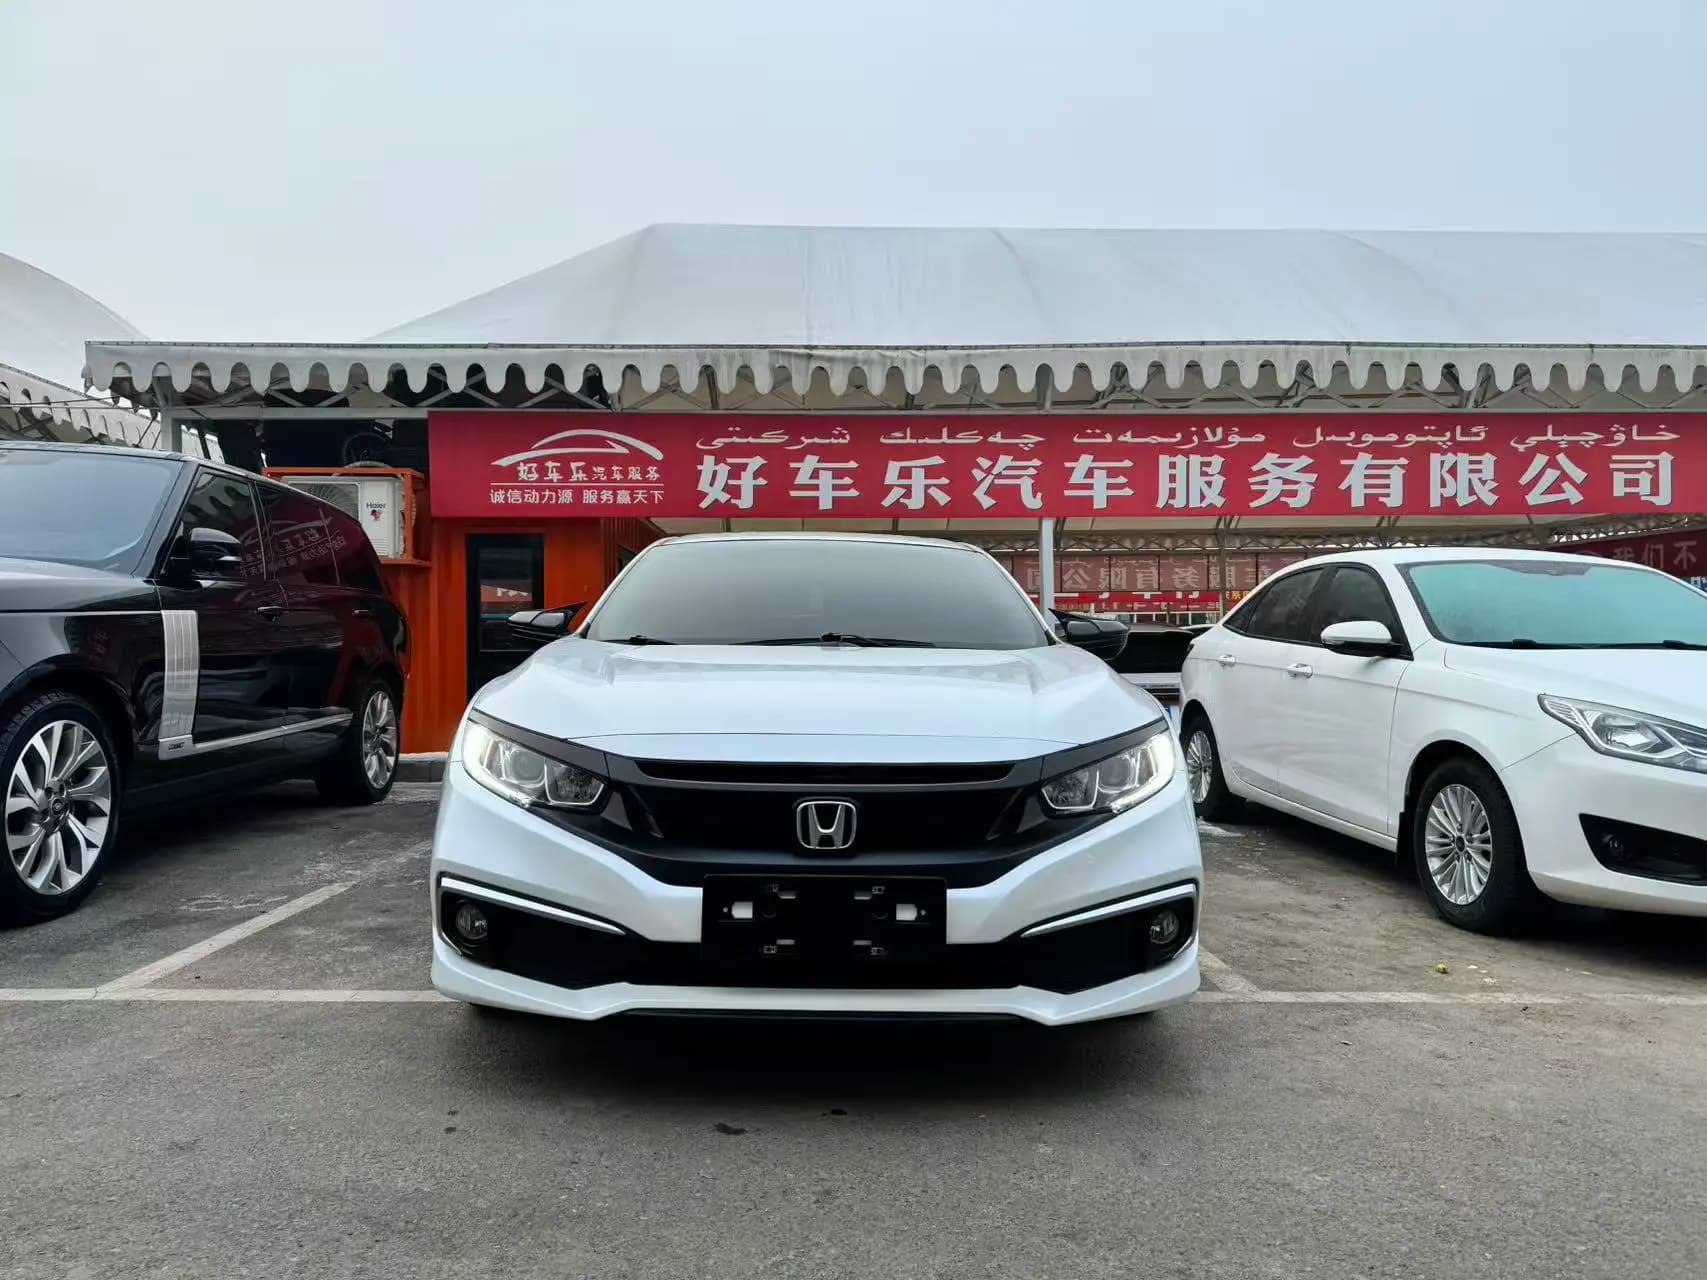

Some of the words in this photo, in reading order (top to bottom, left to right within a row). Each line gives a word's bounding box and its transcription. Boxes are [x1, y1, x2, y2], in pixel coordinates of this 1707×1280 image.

[696, 451, 1676, 510] 好车乐汽车服务有限公司
[489, 489, 573, 504] 诚信动力源
[582, 489, 665, 504] 服务赢天下
[366, 501, 386, 509] Haier
